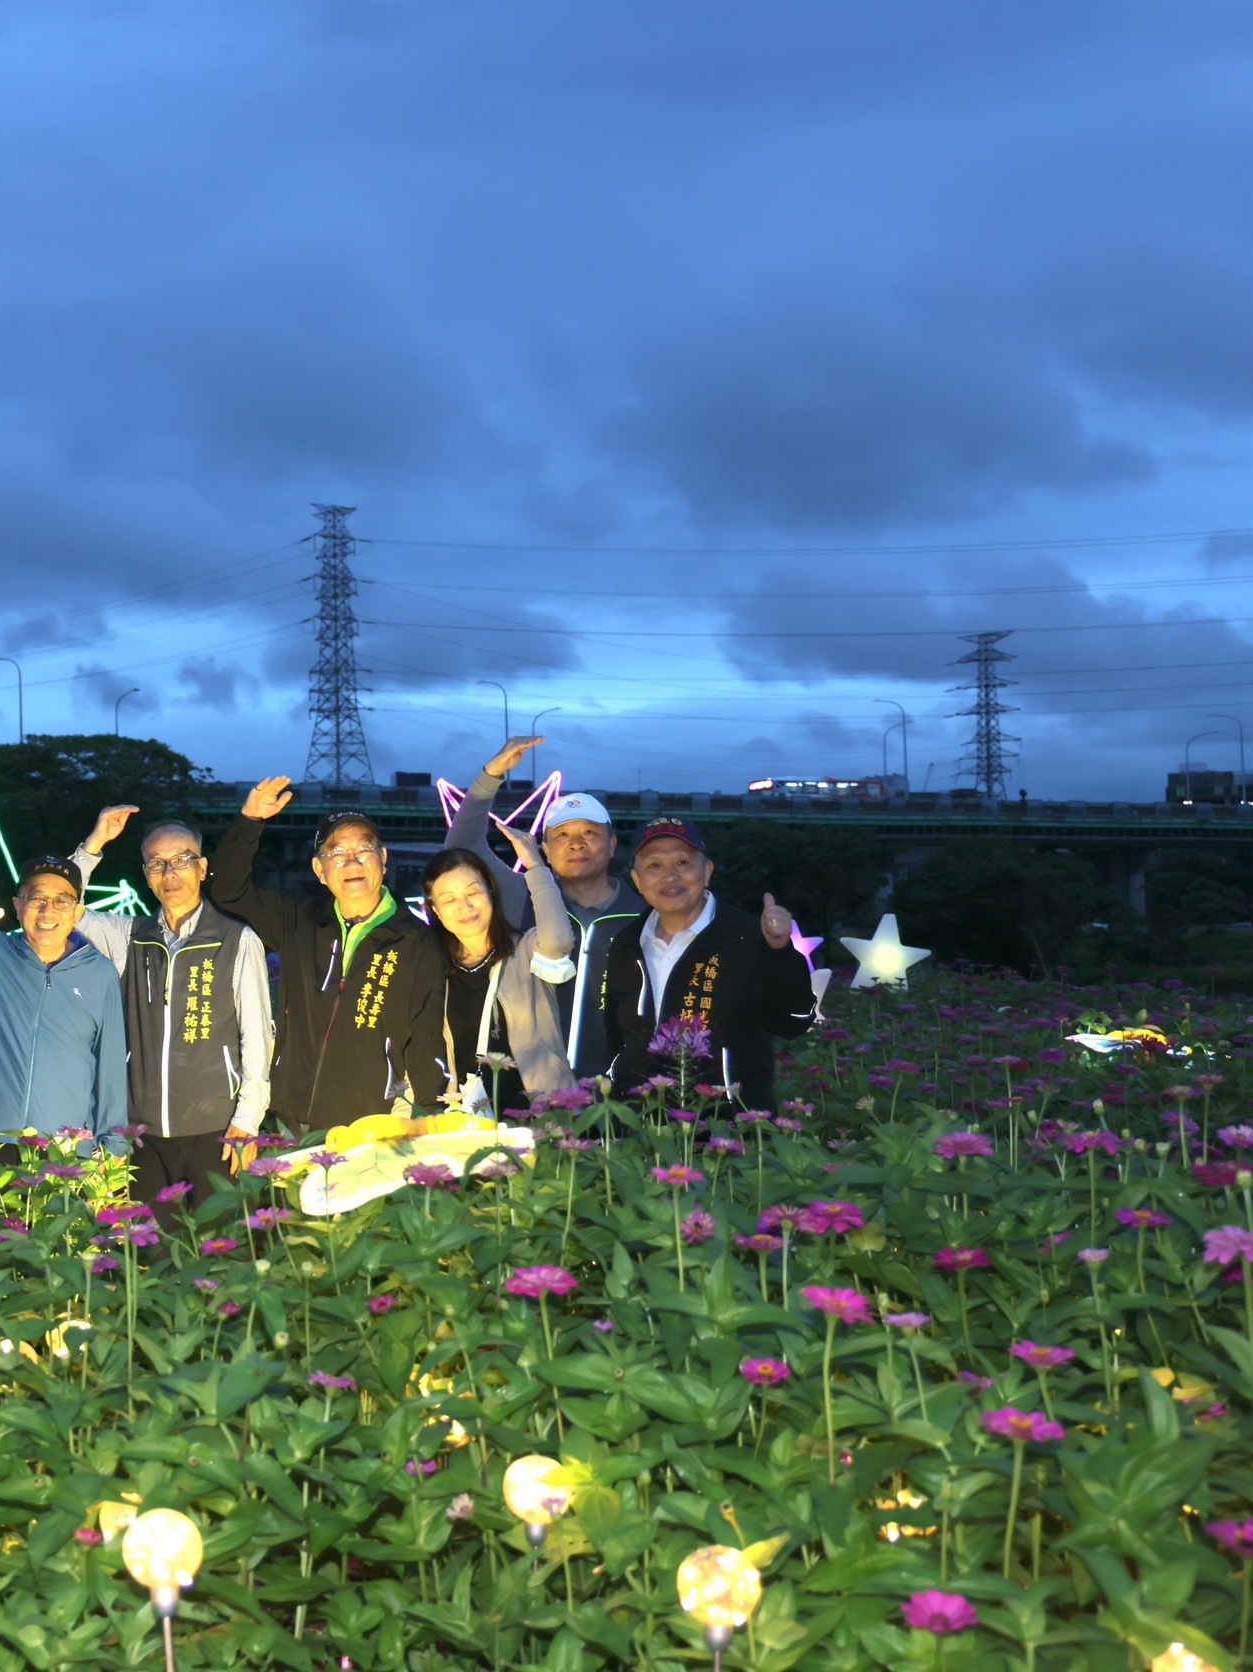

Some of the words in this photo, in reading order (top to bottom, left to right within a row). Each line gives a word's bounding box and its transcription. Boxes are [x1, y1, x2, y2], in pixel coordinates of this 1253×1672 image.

[188, 966, 199, 992] 里長
[202, 958, 214, 996] 板橋區
[366, 953, 383, 979] 里長
[379, 949, 398, 987] 板橋區
[183, 996, 198, 1044] 羅祐祥
[200, 1001, 212, 1039] 正泰里
[366, 990, 384, 1028] 長壽里
